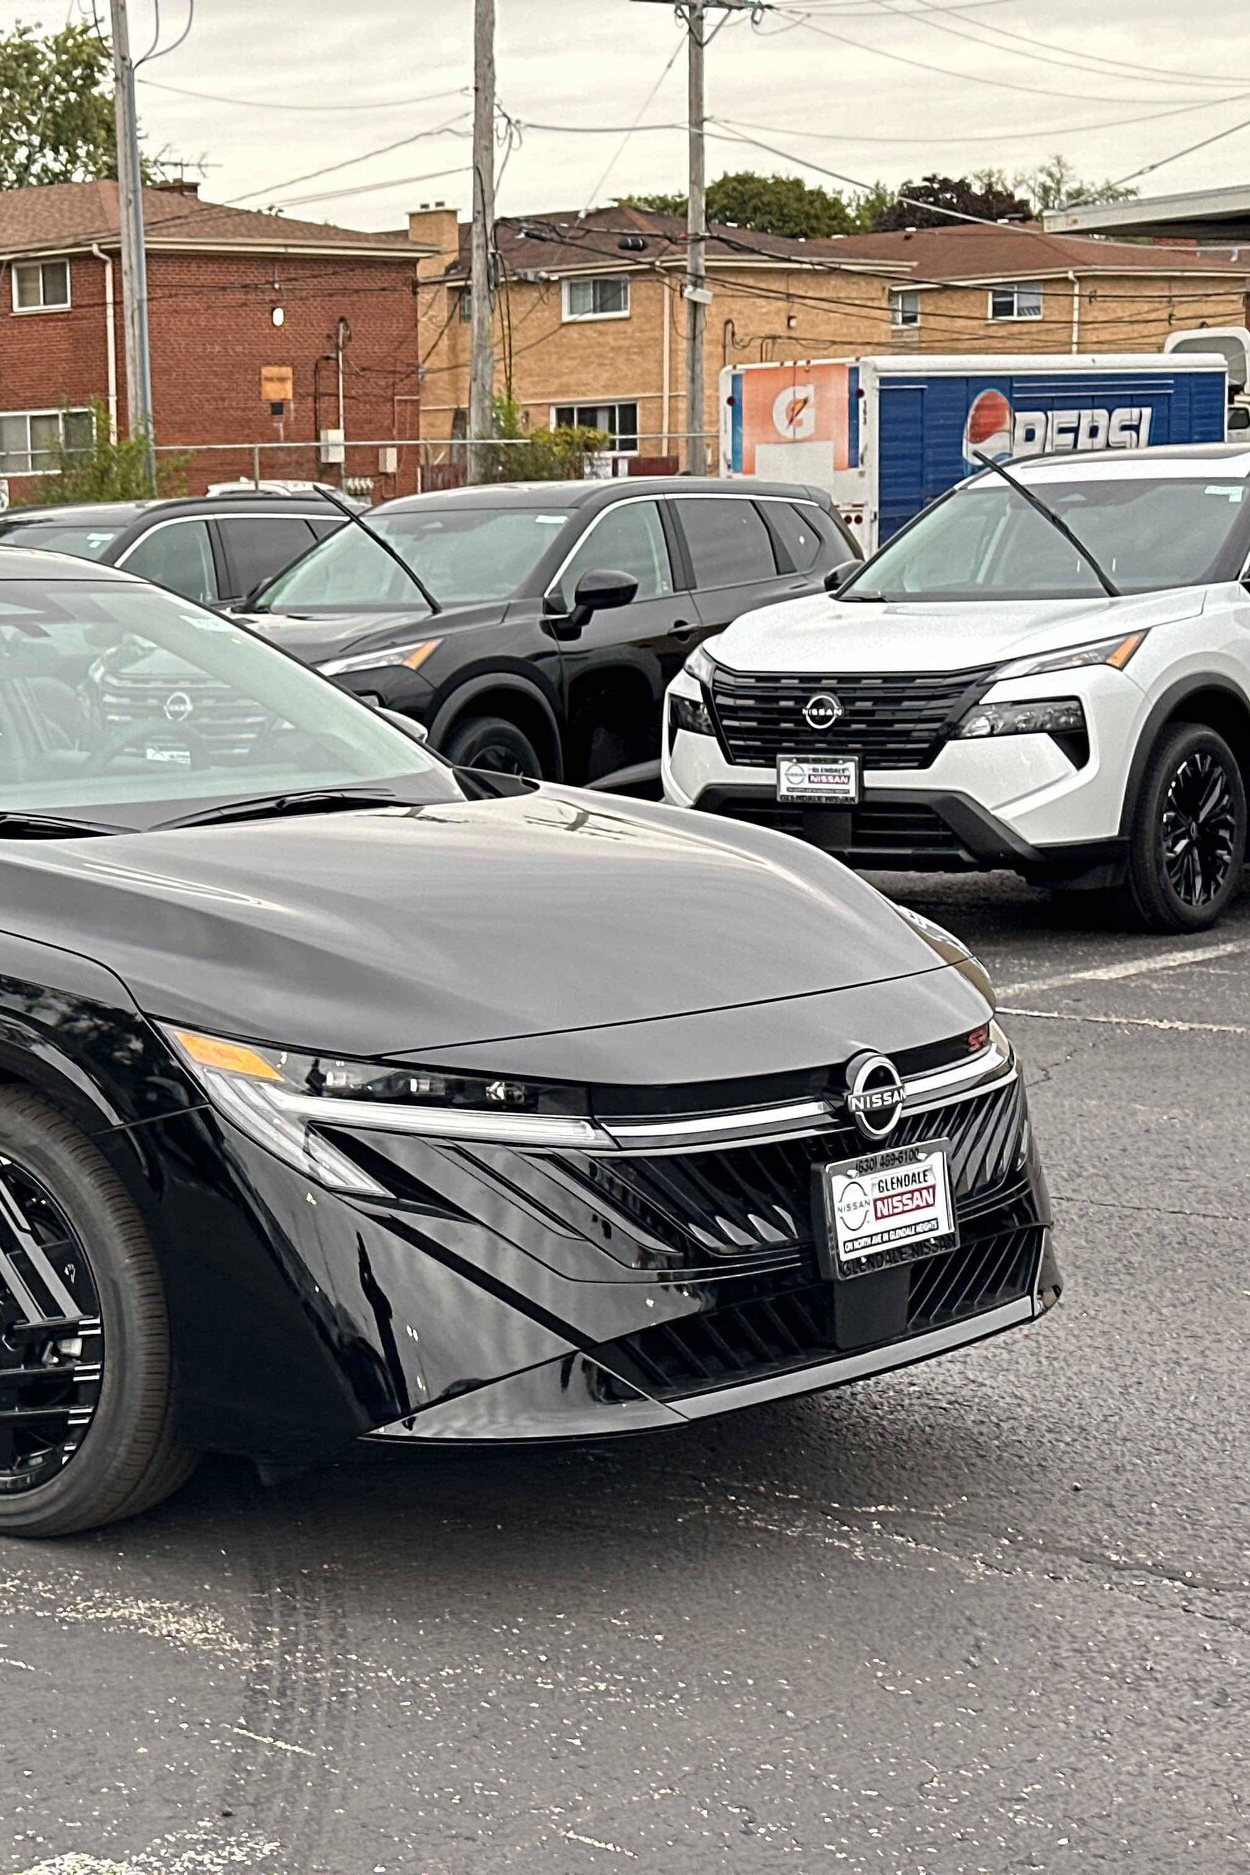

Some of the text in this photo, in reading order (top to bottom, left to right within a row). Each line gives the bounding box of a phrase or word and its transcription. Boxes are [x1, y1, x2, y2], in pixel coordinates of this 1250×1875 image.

[772, 384, 815, 439] G
[1012, 407, 1152, 457] PEPSI
[802, 708, 842, 716] NISSAN
[810, 775, 848, 784] NISSAN
[851, 1088, 907, 1111] NISSAN
[878, 1171, 929, 1193] GLENDALE
[837, 1199, 871, 1214] NISSAN
[876, 1188, 934, 1217] NISSAN
